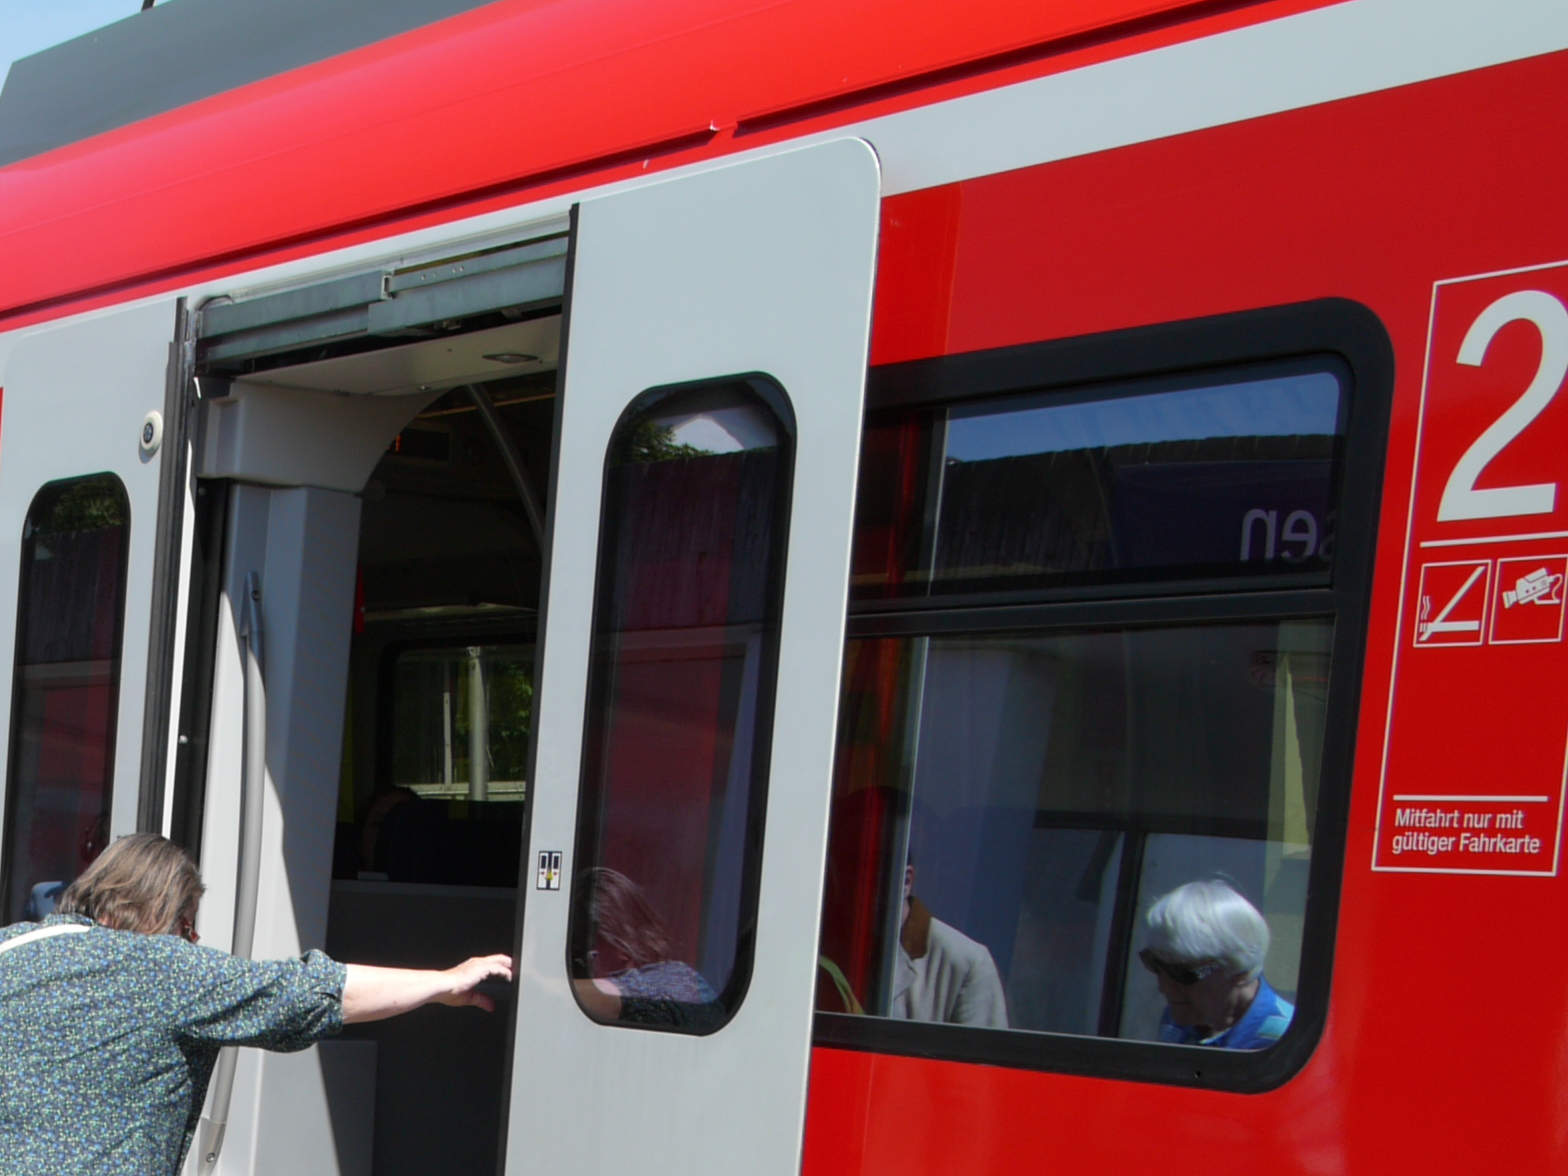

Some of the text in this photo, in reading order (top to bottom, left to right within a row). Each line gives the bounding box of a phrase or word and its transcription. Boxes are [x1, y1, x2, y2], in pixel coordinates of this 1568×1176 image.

[1436, 289, 1568, 522] 2
[1394, 808, 1525, 829] Mitfahrt nur mit
[1392, 831, 1541, 855] gültiger Fahrkarte
